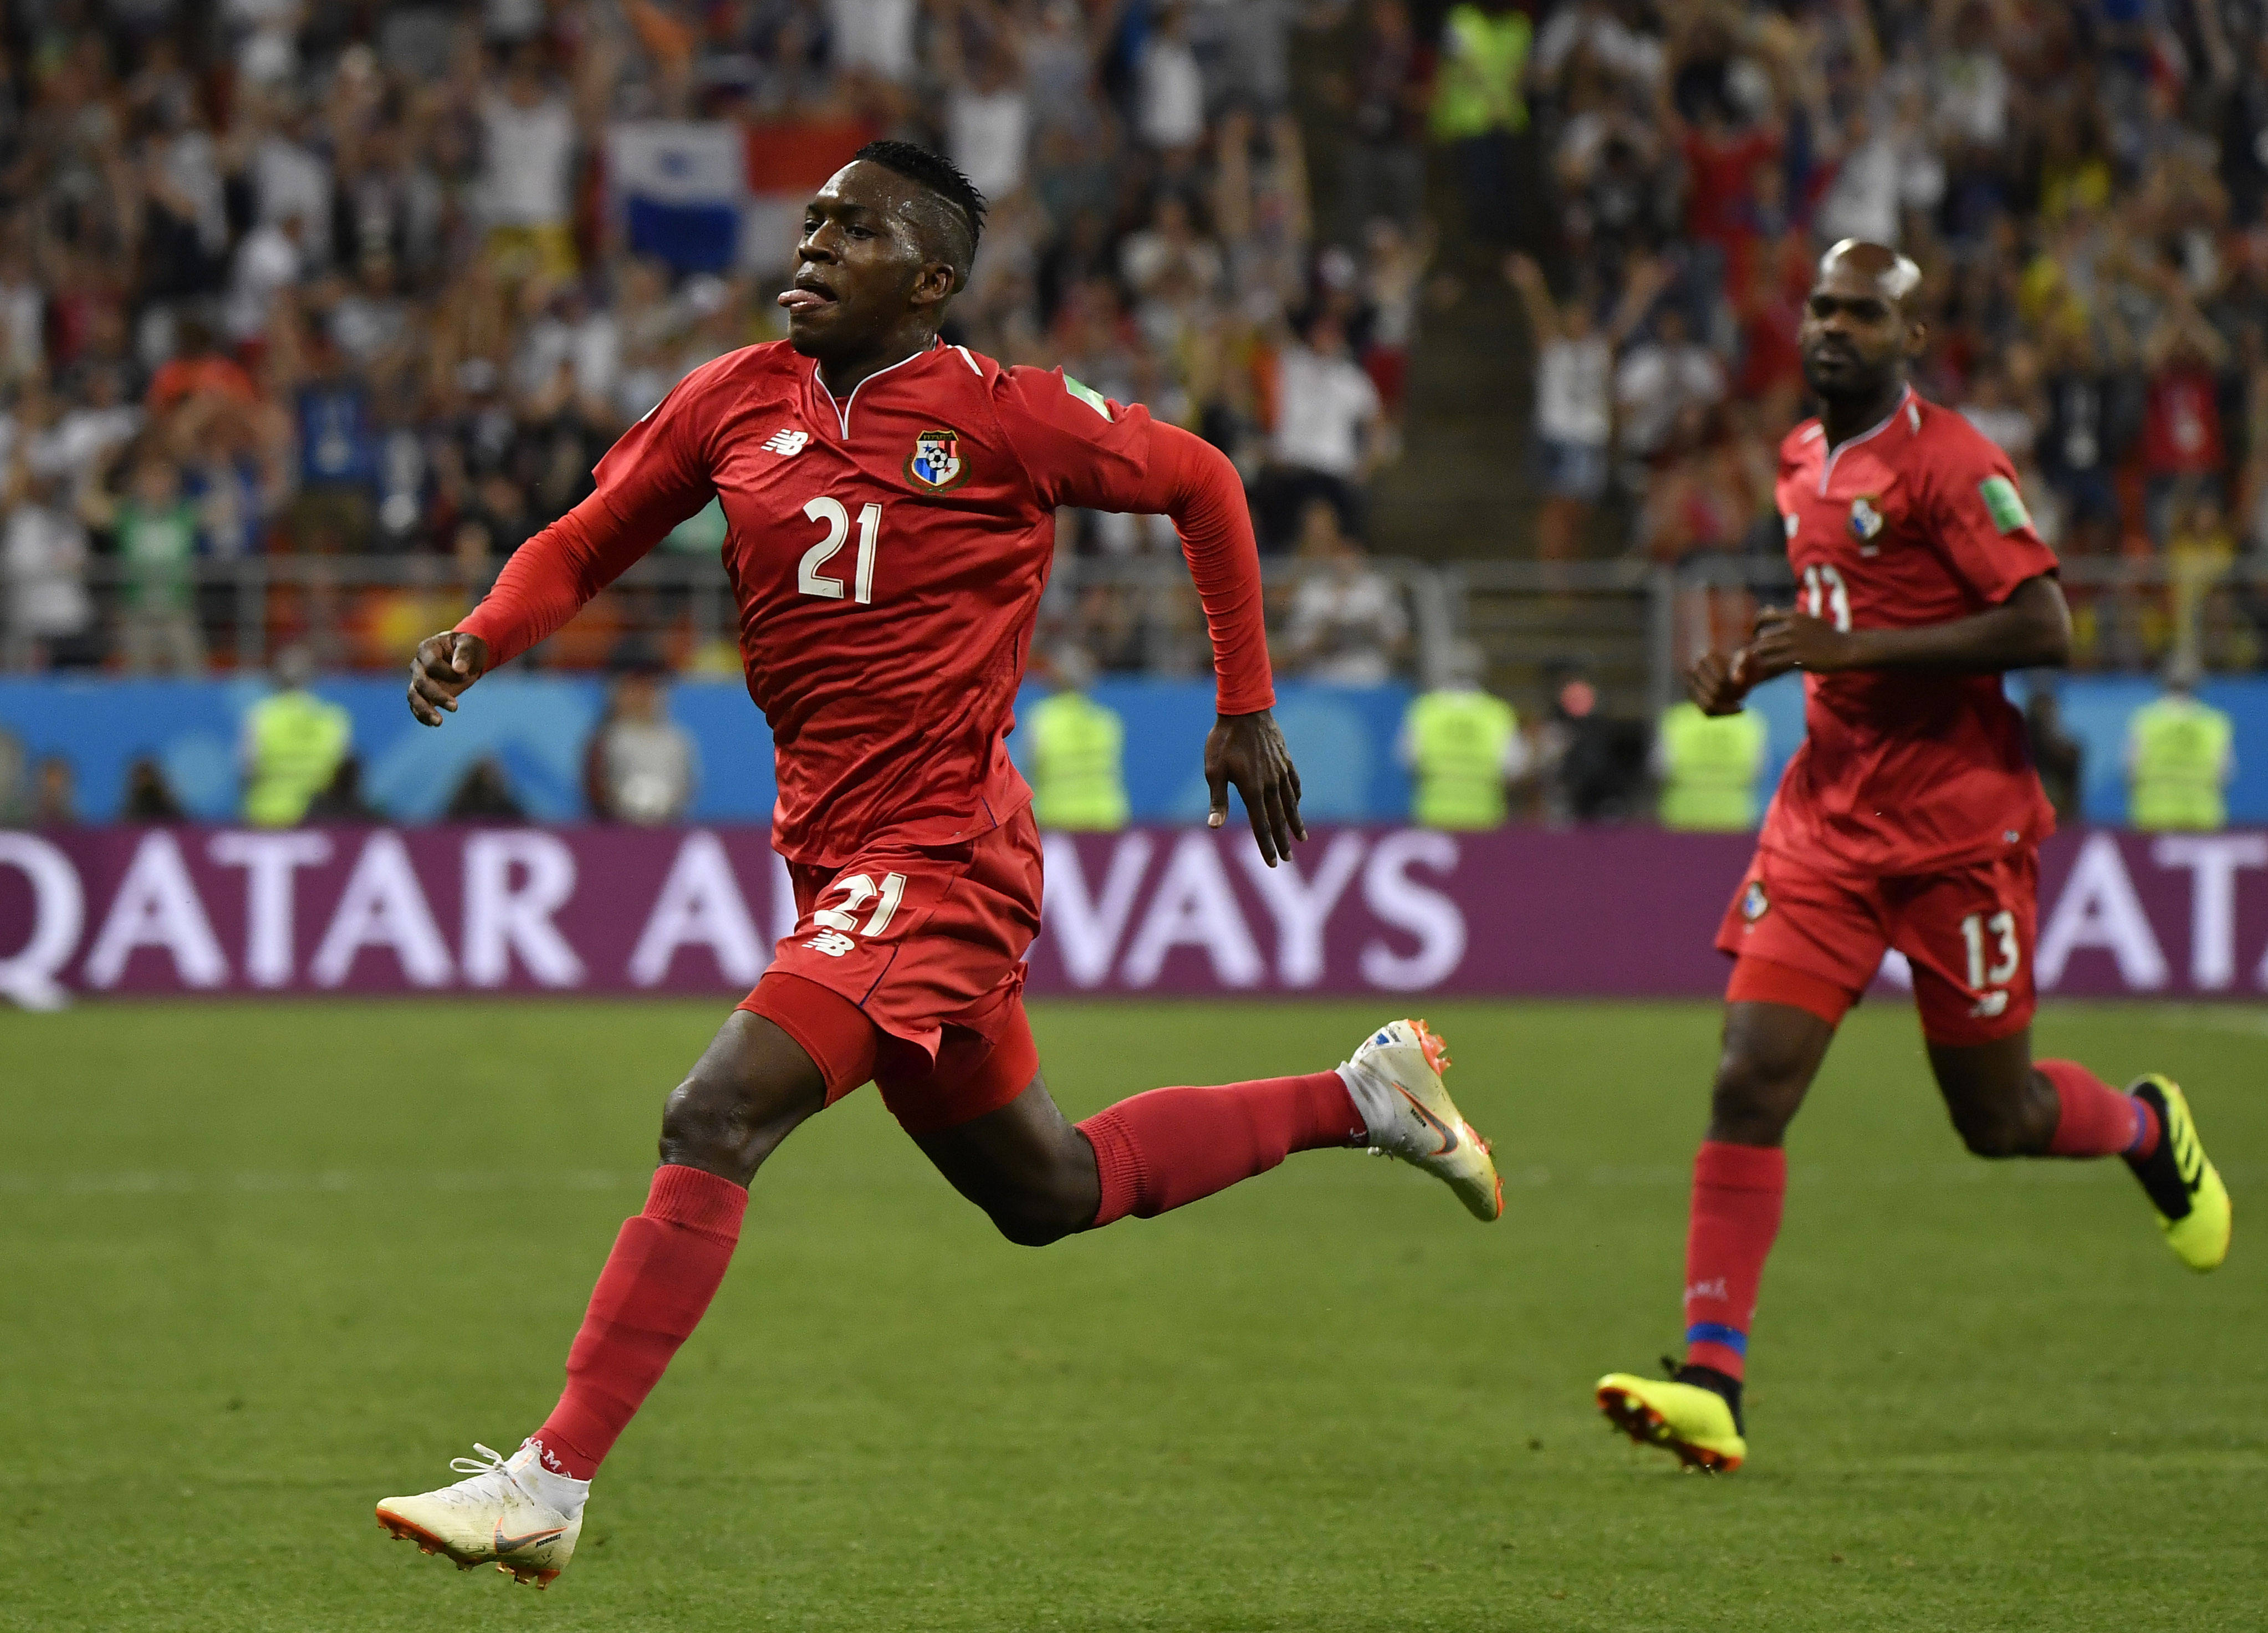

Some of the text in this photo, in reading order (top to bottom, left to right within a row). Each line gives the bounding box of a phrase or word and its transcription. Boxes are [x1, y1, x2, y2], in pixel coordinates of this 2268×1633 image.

[798, 496, 882, 604] 21
[0, 831, 1467, 1009] QATAR AWAYS
[813, 871, 907, 937] 21
[1960, 910, 2019, 991] 13
